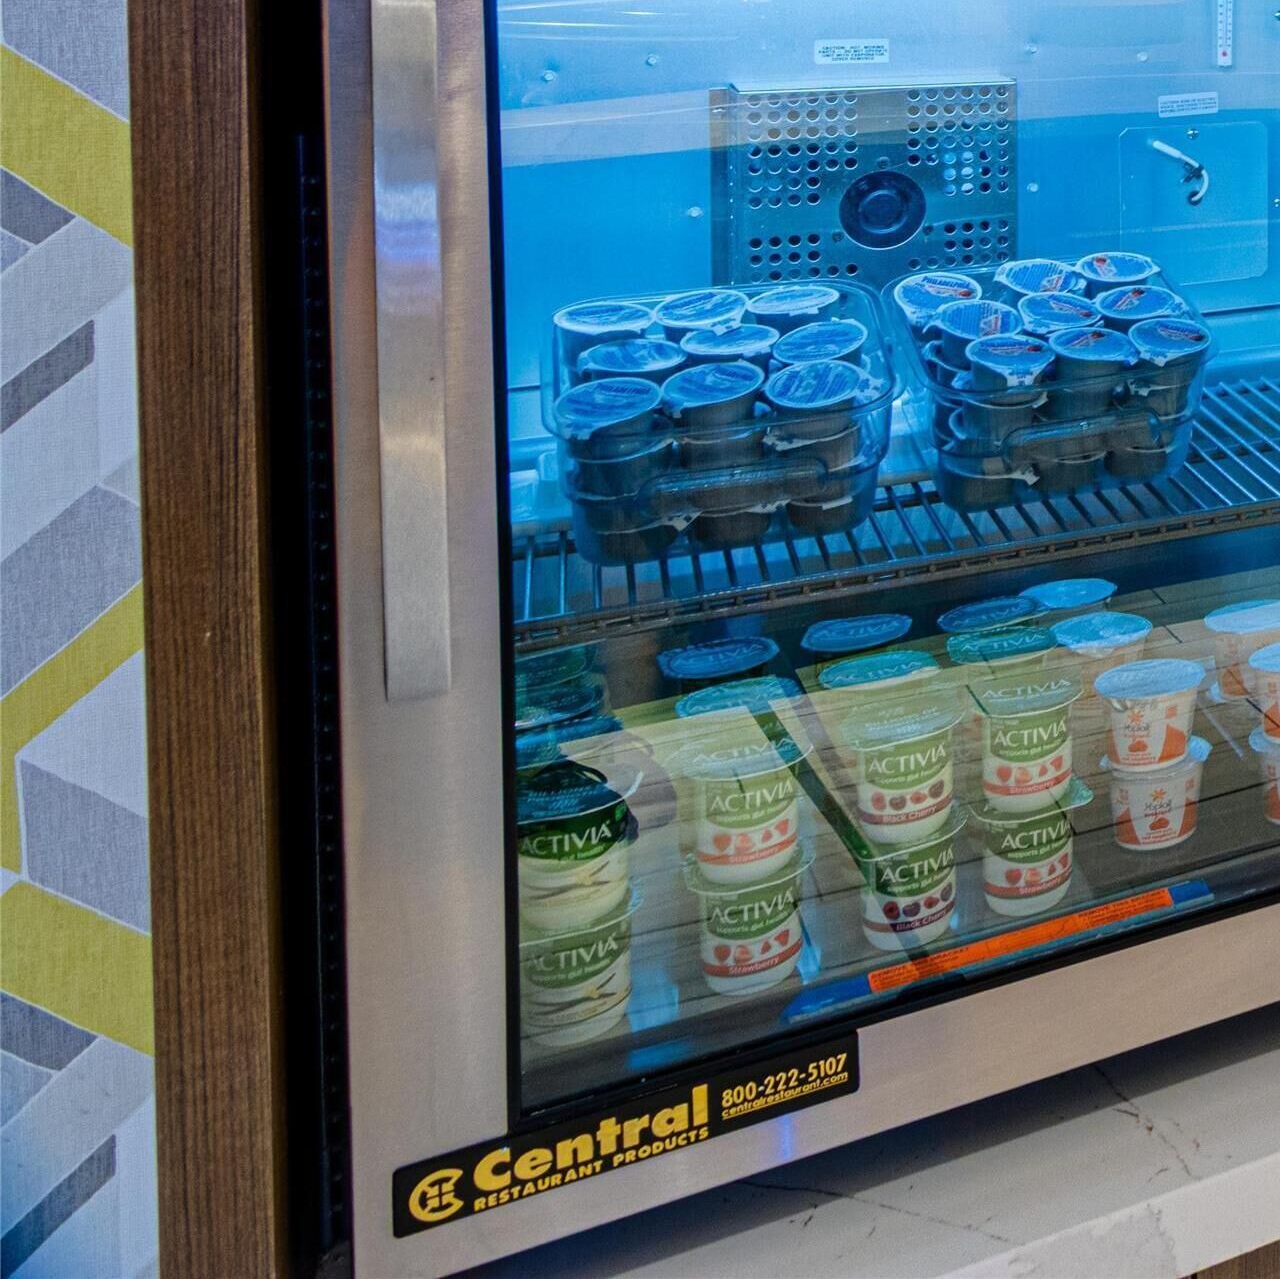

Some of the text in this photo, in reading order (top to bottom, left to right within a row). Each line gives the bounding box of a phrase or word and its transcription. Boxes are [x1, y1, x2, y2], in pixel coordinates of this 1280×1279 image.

[982, 678, 1072, 699] ACTIVIA
[994, 716, 1067, 747] ACTIVIA
[868, 740, 947, 774] ACTIVIA
[710, 779, 794, 812] ACTIVIA
[521, 821, 613, 855] ACTIVIA
[1001, 818, 1072, 850] ACTIVIA
[880, 844, 954, 883] ACTIVIA
[710, 887, 794, 924] ACTIVIA
[526, 934, 619, 972] ACTIVIA
[721, 1053, 847, 1108] 800-222-5107
[721, 1072, 848, 1117] centralrestaurant.com
[473, 1083, 709, 1192] Central
[474, 1126, 709, 1212] RESTAURANT PRODUCTS
